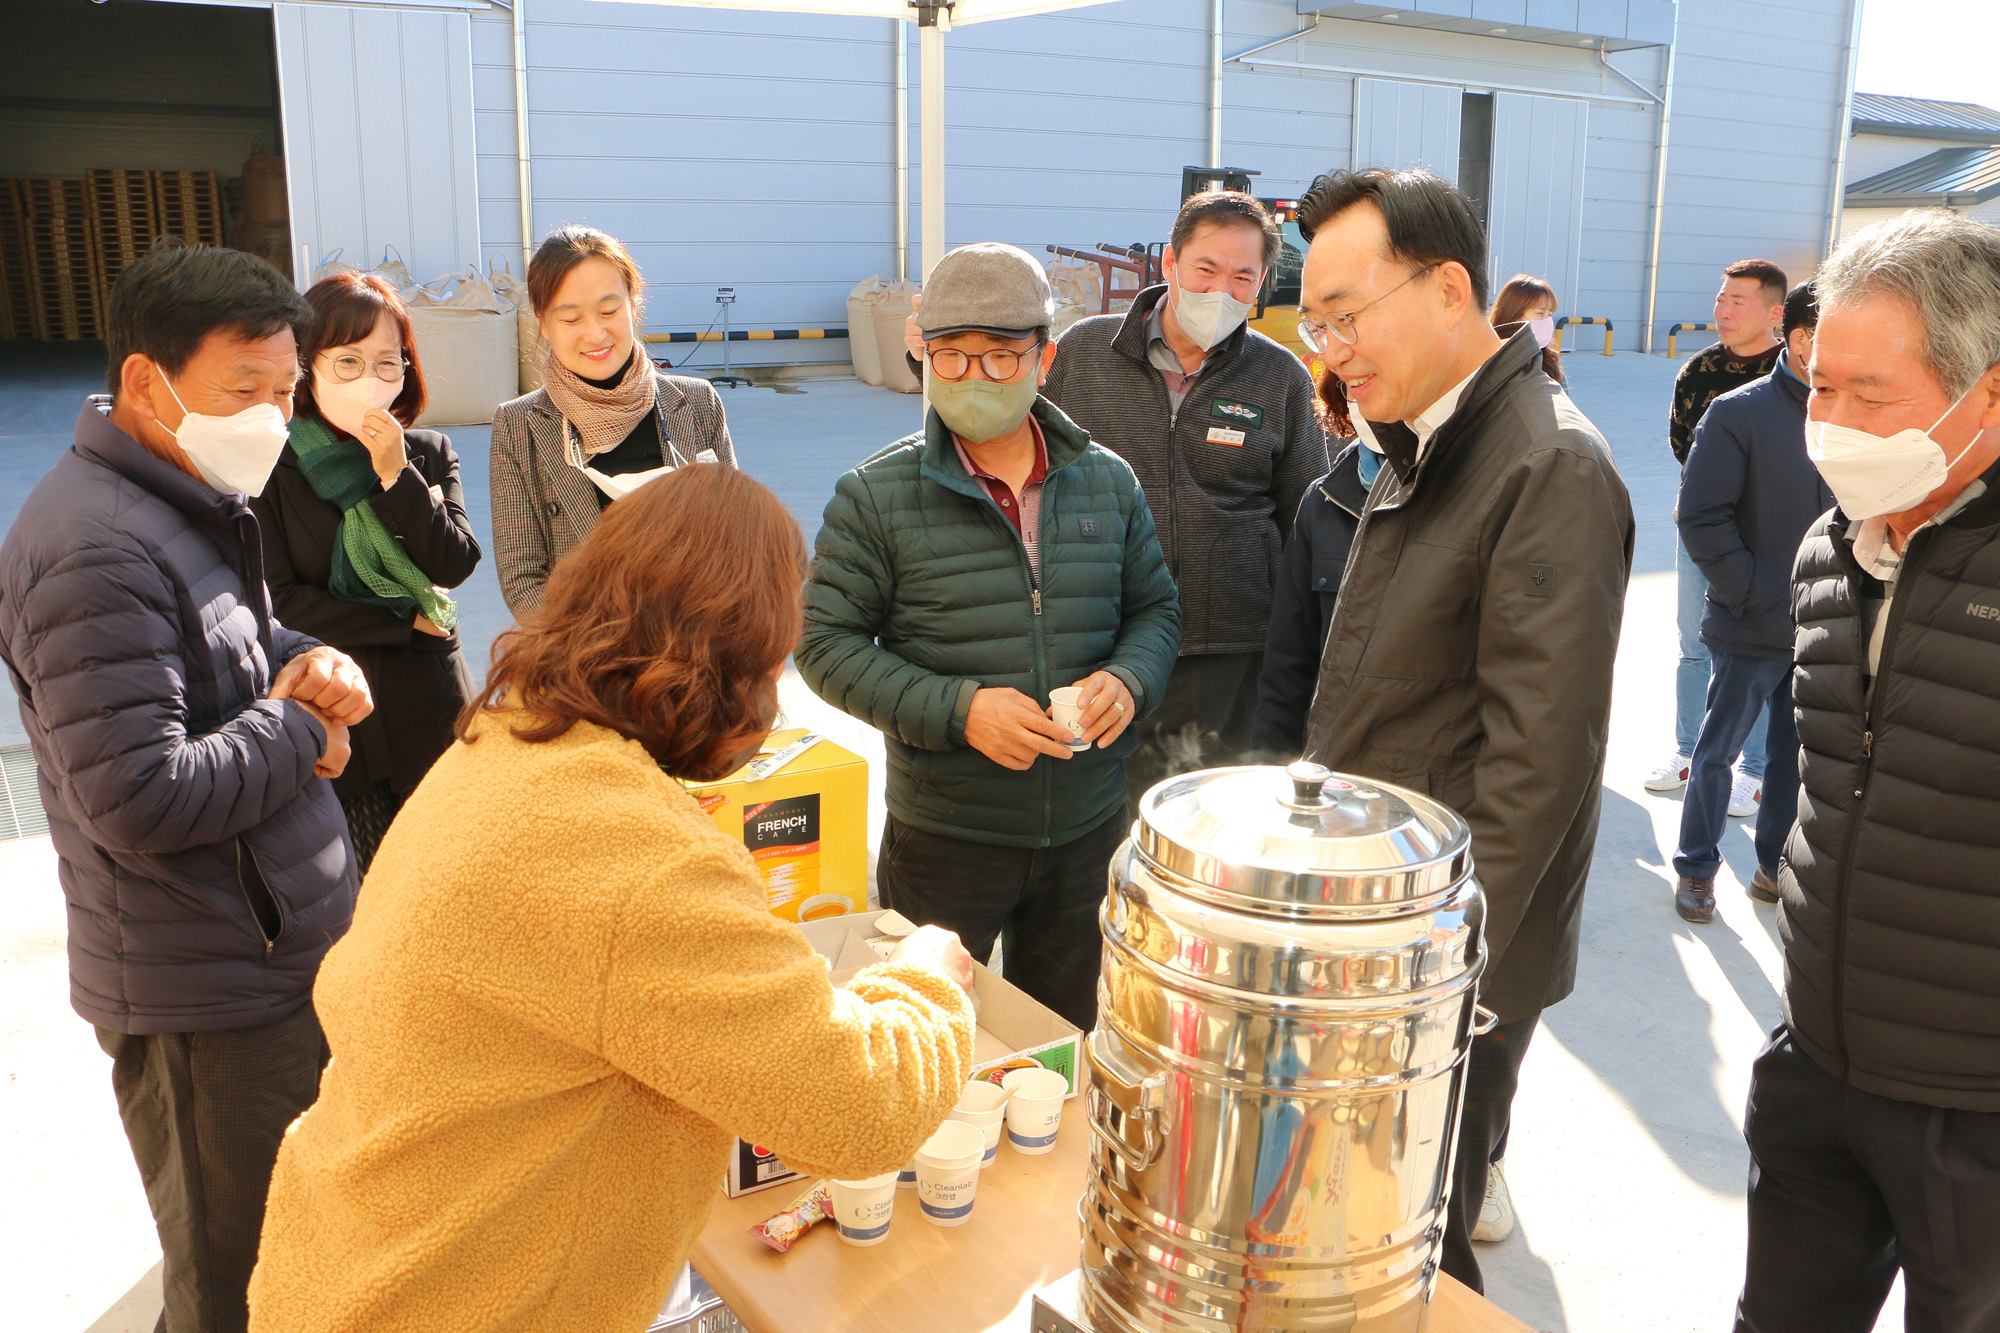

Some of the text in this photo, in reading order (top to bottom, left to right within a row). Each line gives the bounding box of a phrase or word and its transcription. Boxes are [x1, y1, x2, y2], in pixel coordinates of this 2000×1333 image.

[757, 814, 807, 833] FRENCH
[757, 825, 807, 841] CAFE
[934, 1181, 973, 1191] Cleanlab
[935, 1192, 956, 1201] 크린랩
